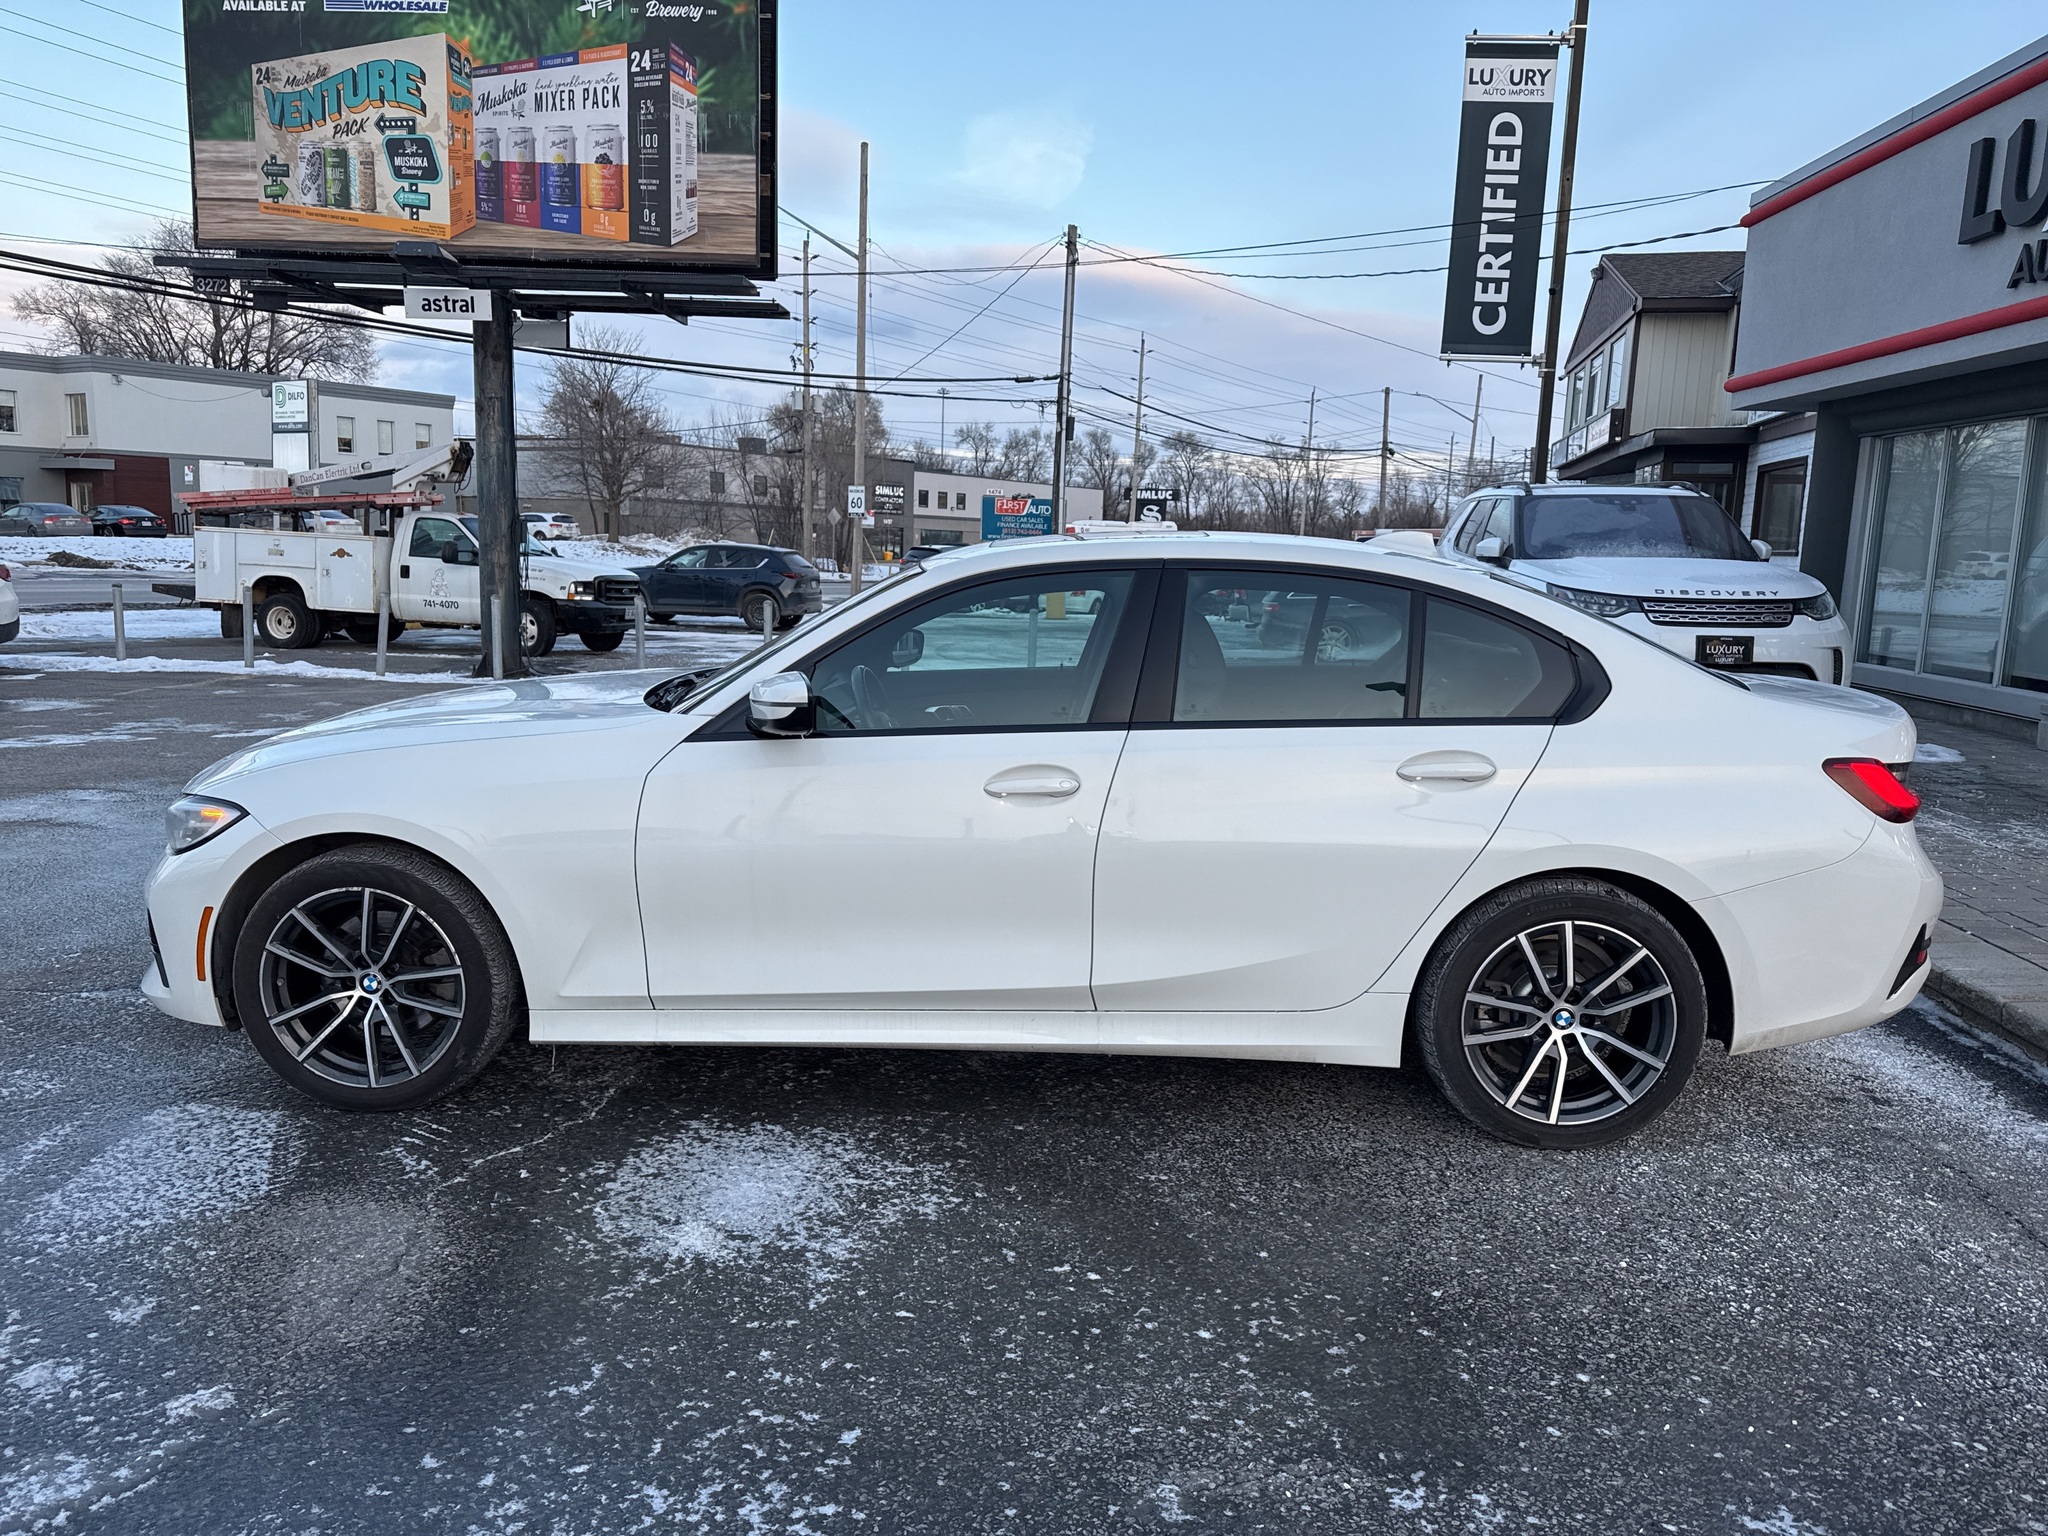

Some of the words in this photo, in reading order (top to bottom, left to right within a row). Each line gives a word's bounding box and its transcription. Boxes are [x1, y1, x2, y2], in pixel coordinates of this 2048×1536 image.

[222, 0, 289, 12] AVAILABLE
[290, 0, 306, 12] AT
[364, 0, 448, 12] WHOLESALE
[645, 0, 704, 22] Brewery
[630, 49, 652, 73] 24
[255, 66, 271, 86] 24
[283, 65, 328, 89] Muskoka
[535, 78, 554, 90] hard
[555, 75, 593, 94] sparkling
[595, 71, 620, 85] water
[1468, 63, 1552, 88] LUXURY
[262, 59, 426, 134] VENTURE
[474, 79, 528, 117] Muskoka
[534, 88, 576, 113] MIXER
[582, 85, 620, 110] PACK
[1482, 88, 1506, 96] AUTO
[1508, 88, 1545, 97] IMPORTS
[332, 117, 368, 139] PACK
[640, 133, 658, 148] 100
[394, 156, 429, 168] MUSKOKA
[1471, 111, 1523, 336] CERTIFIED
[196, 277, 228, 292] 3272
[421, 295, 475, 313] astral
[287, 391, 305, 401] DILFO
[300, 472, 324, 484] DanCan
[325, 468, 348, 479] Electric
[349, 464, 361, 474] Ltd.
[875, 485, 904, 497] SIMLUC
[1130, 490, 1173, 500] IMLUC
[850, 497, 863, 509] 60
[1027, 505, 1051, 515] AUTO
[1654, 589, 1779, 597] DISCOVERY
[422, 599, 459, 610] 741-4070
[1706, 643, 1745, 655] LUXURY
